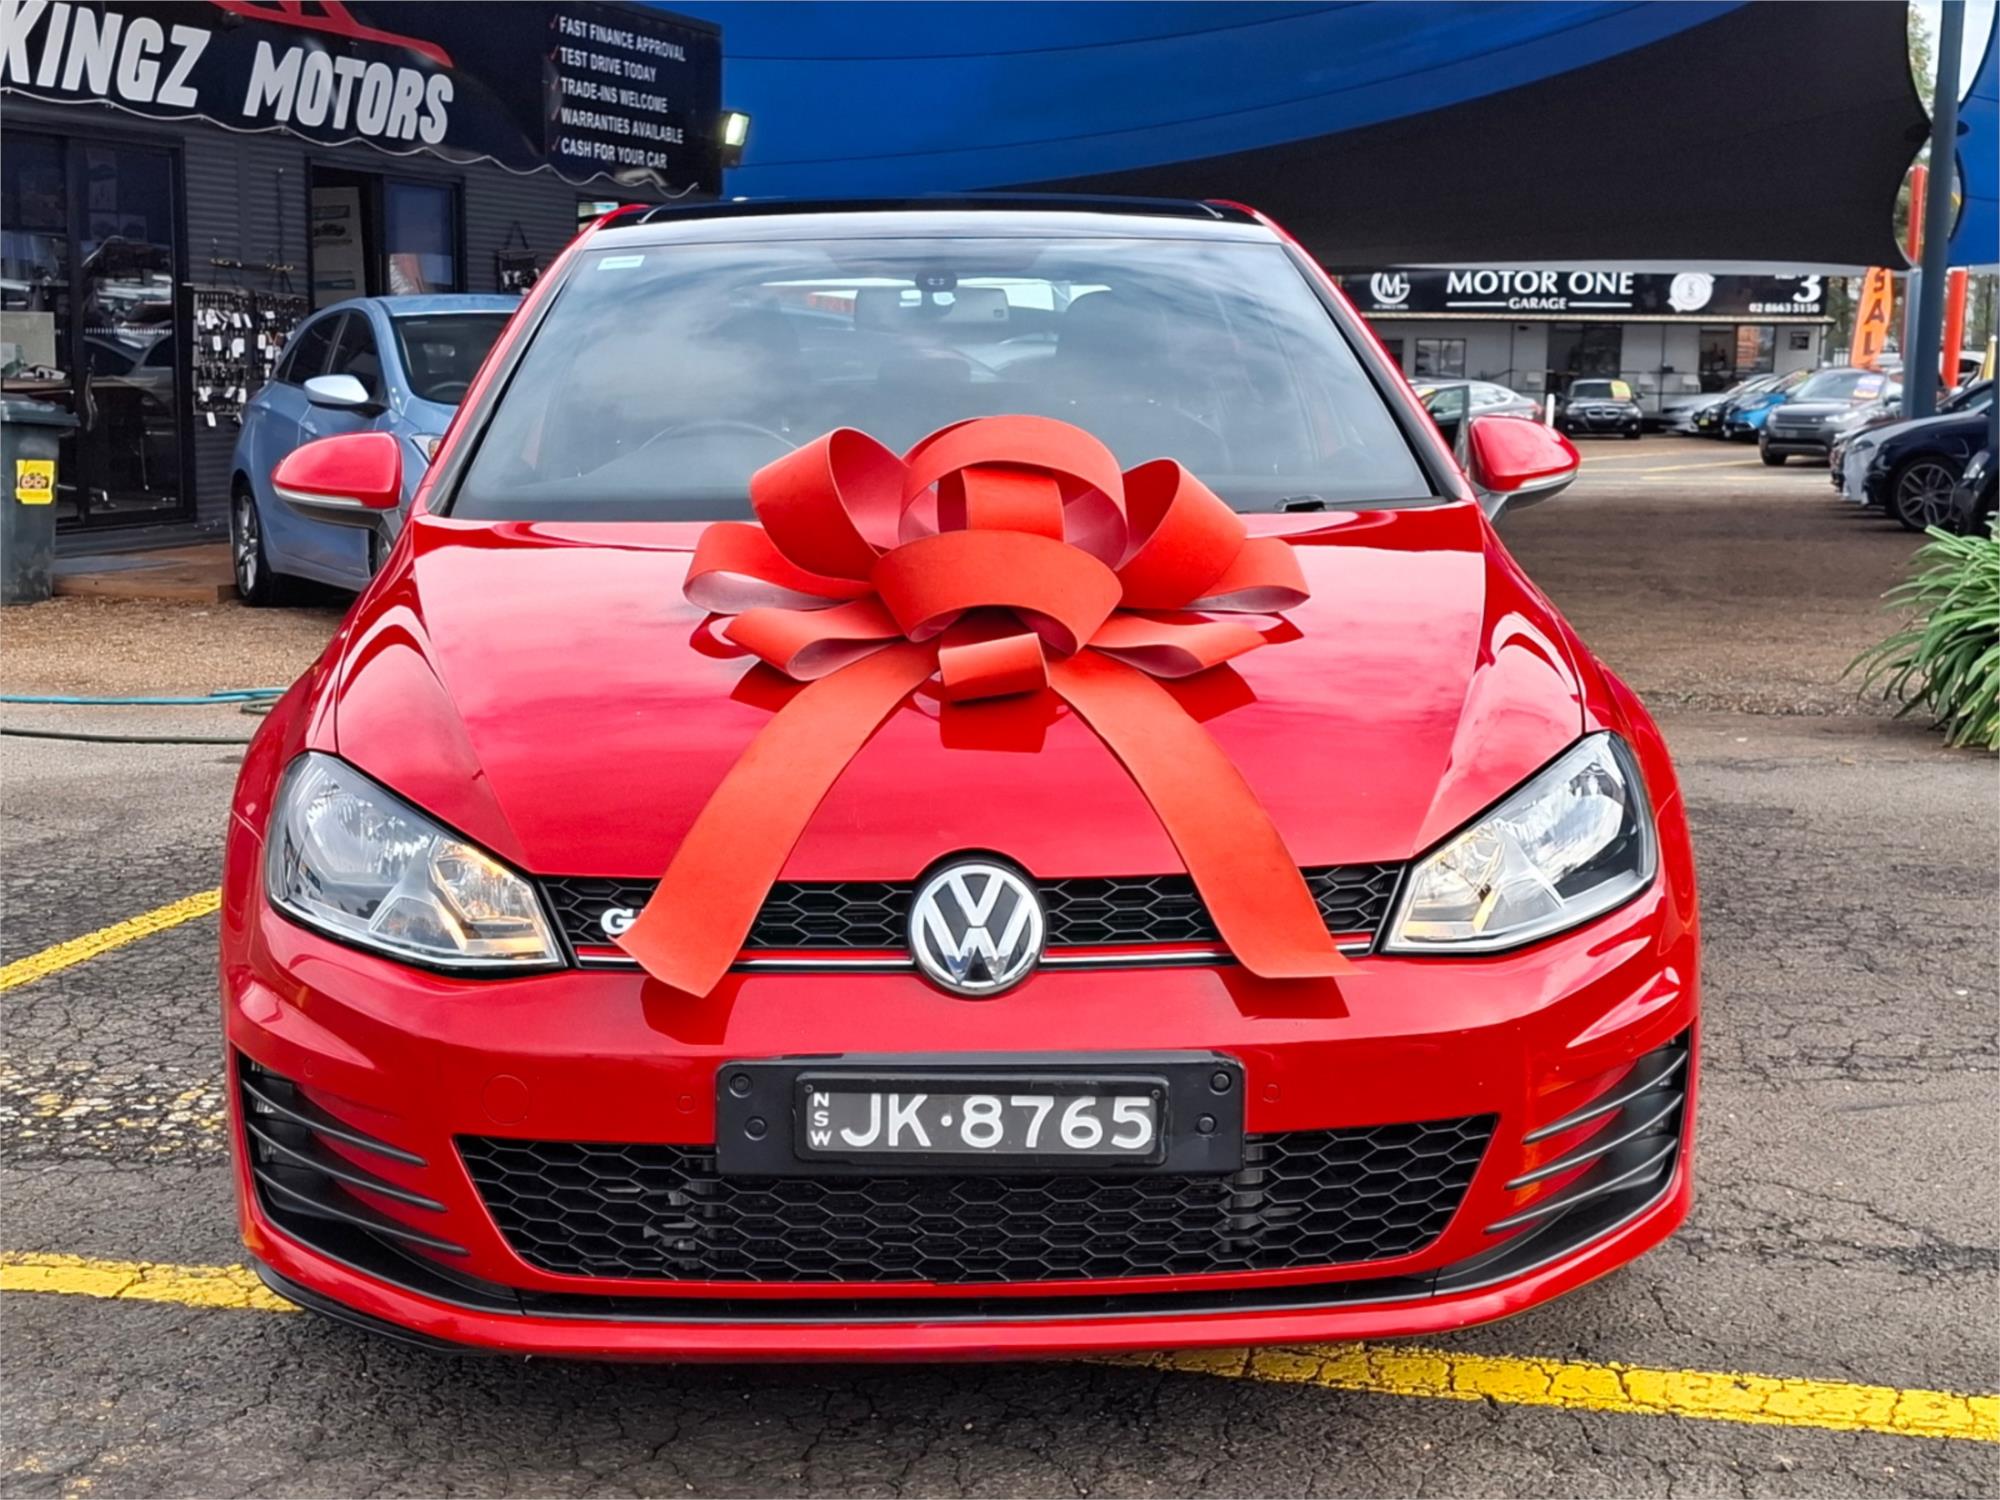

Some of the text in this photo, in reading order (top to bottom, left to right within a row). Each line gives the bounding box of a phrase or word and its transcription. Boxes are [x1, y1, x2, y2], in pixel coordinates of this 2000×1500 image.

[559, 16, 686, 62] FAST FINANCE APPROVAL
[0, 0, 455, 145] KINGZ MOTORS
[560, 47, 656, 82] TEST DRIVE TODAY
[560, 77, 668, 113] TRADE-INS WELCOME
[560, 107, 684, 144] WARRANTIES AVAILABLE
[561, 137, 668, 169] CASH FOR YOUR CAR
[1446, 270, 1634, 294] MOTOR ONE
[1792, 273, 1821, 303] 3
[1508, 297, 1567, 310] GARAGE
[1863, 267, 1886, 366] SAL
[810, 1092, 832, 1146] NSW
